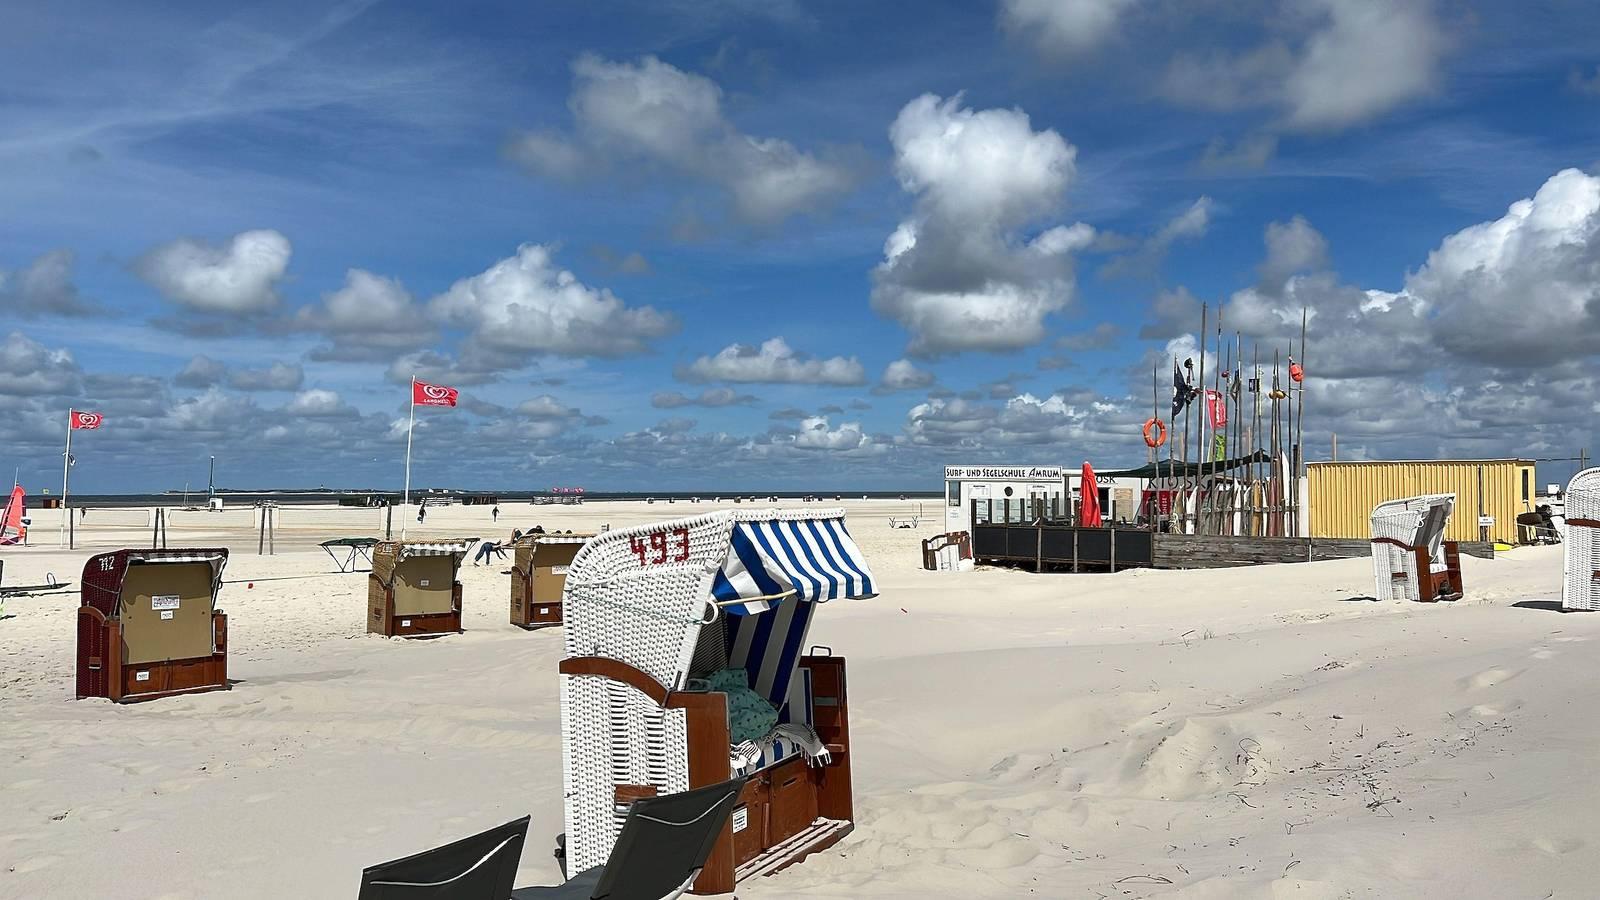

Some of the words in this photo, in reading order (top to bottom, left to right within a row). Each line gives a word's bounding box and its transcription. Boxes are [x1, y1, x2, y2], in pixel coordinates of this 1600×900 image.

[946, 468, 965, 477] SURF-
[966, 469, 980, 477] UND
[982, 468, 1026, 478] SEGELSCHULE
[1028, 468, 1060, 478] AMRUM
[629, 528, 690, 567] 493
